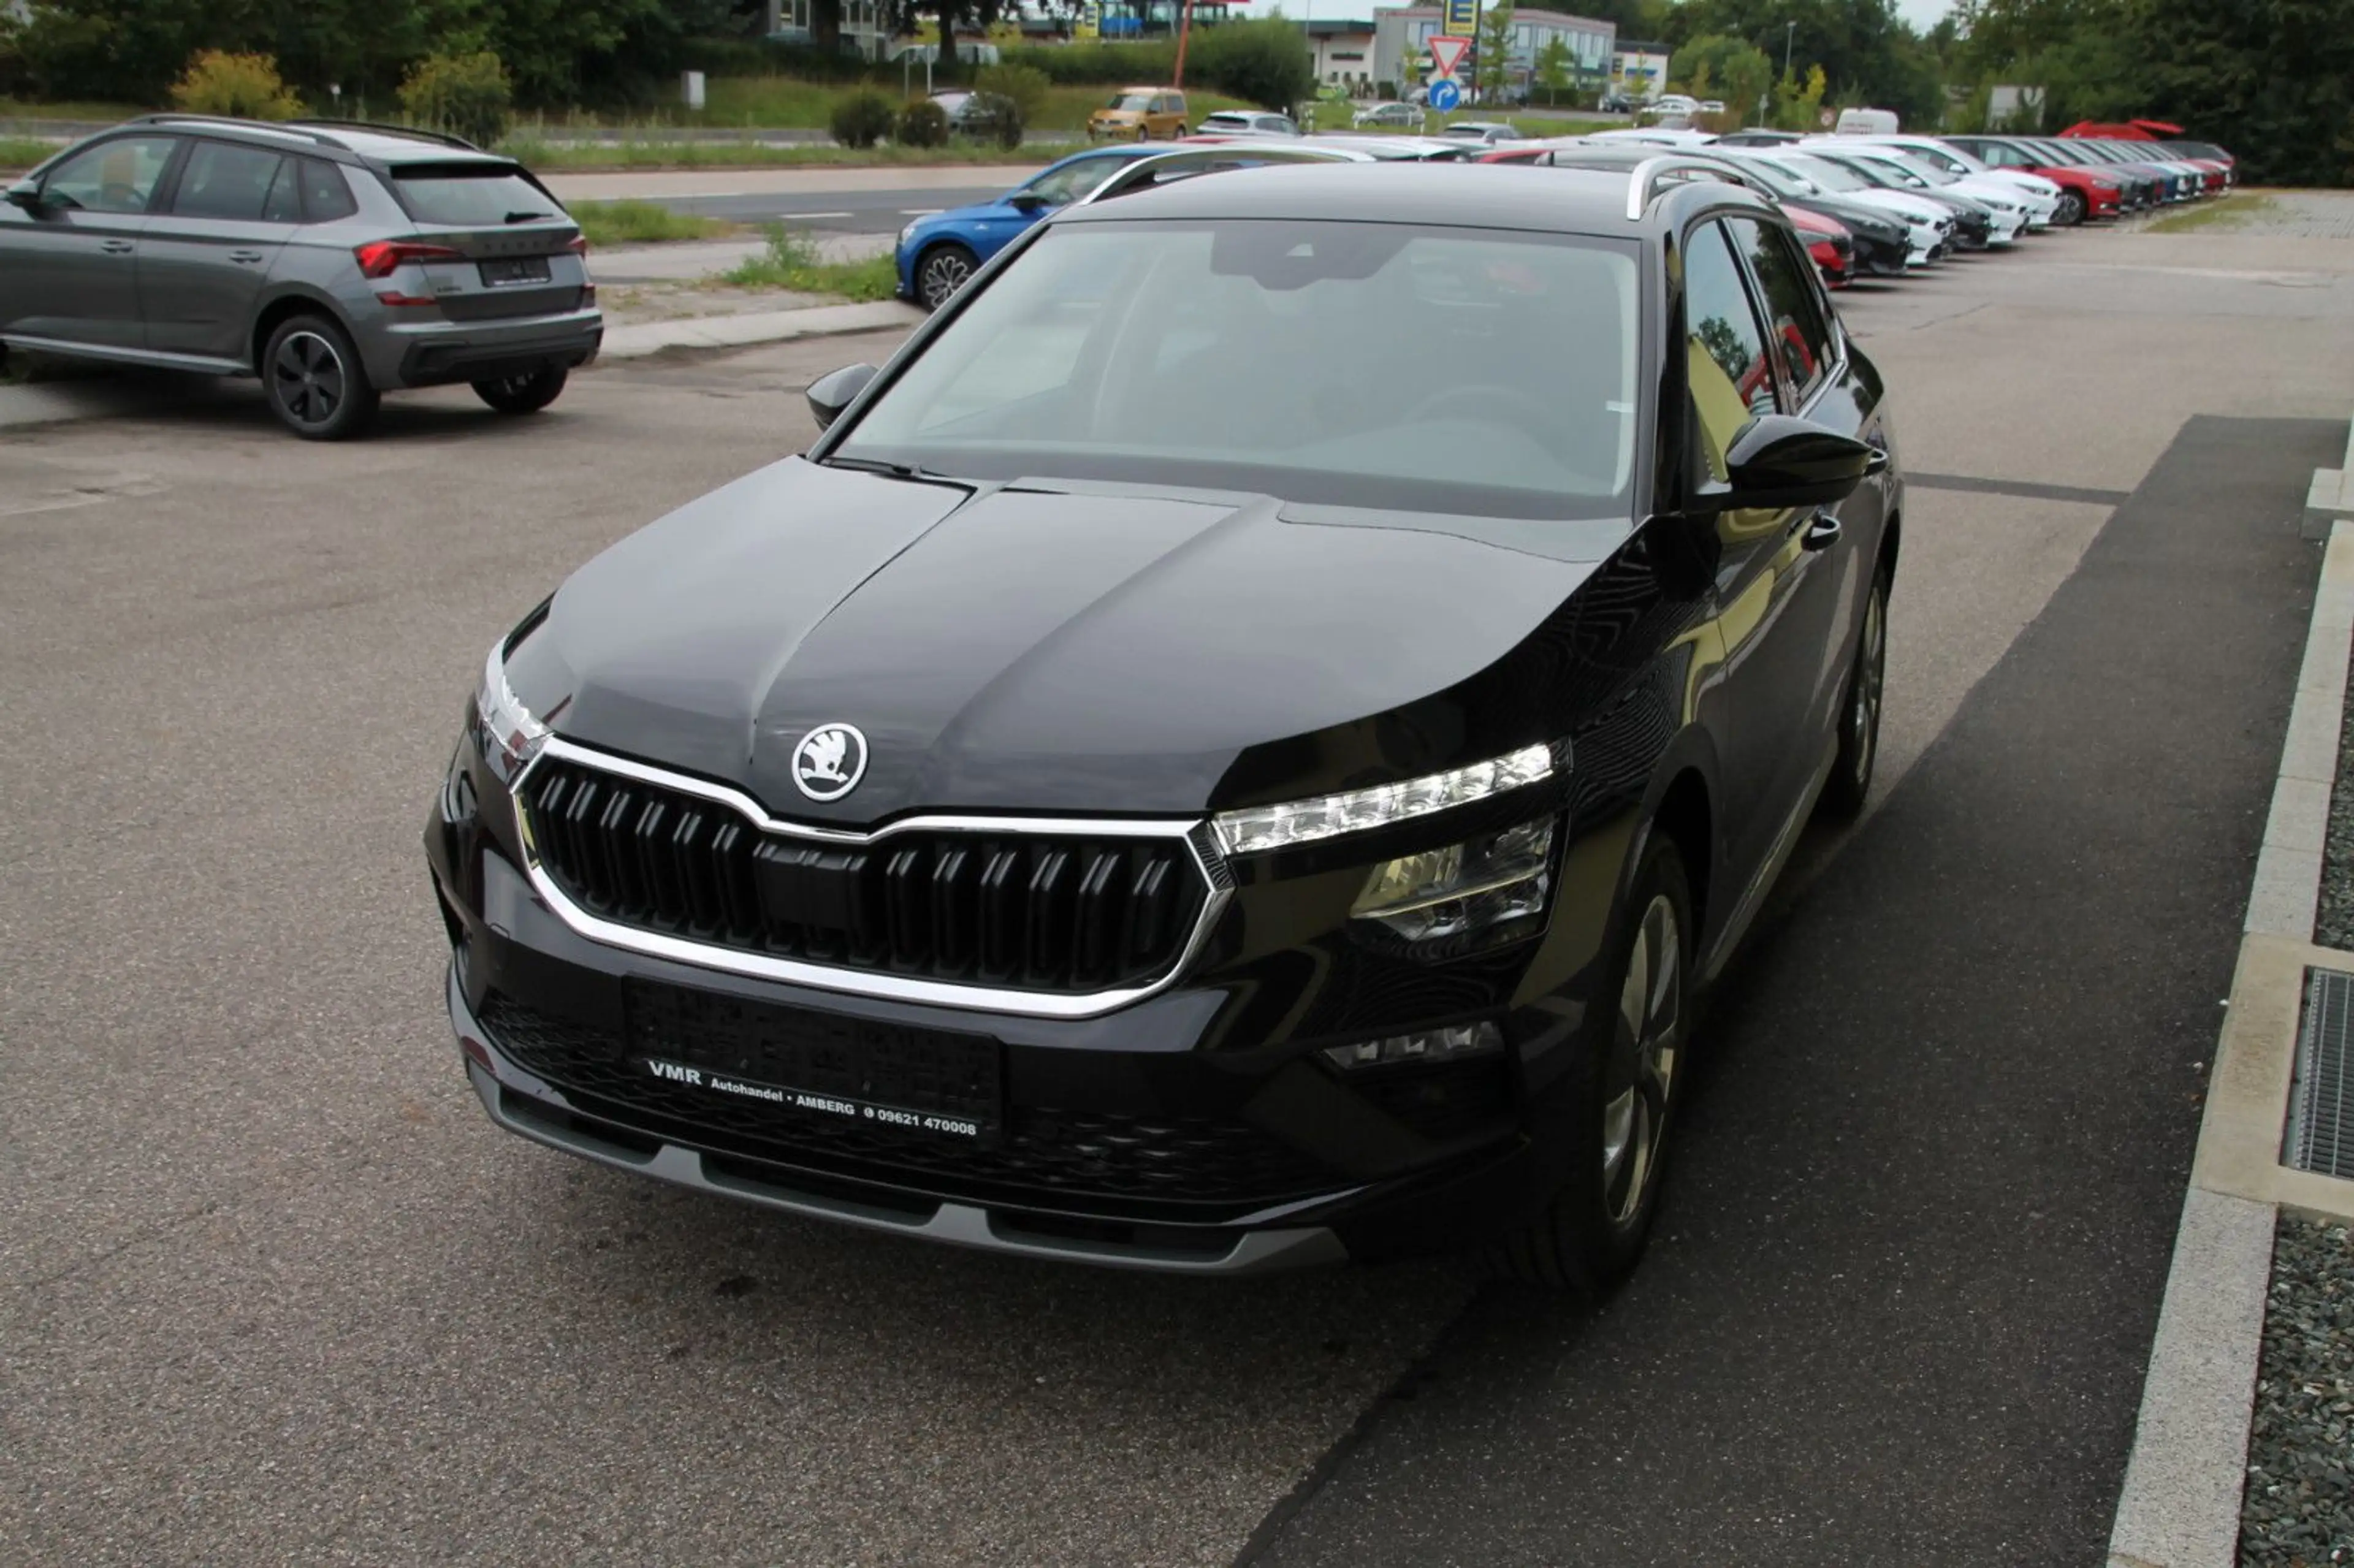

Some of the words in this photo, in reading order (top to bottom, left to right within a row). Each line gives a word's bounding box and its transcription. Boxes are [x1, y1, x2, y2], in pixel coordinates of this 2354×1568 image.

[1450, 0, 1472, 23] E
[648, 1060, 702, 1085] VMR
[711, 1077, 783, 1102] Autohandel
[796, 1095, 855, 1115] AMBERG
[878, 1109, 920, 1126] 09621
[924, 1117, 977, 1135] 470008
